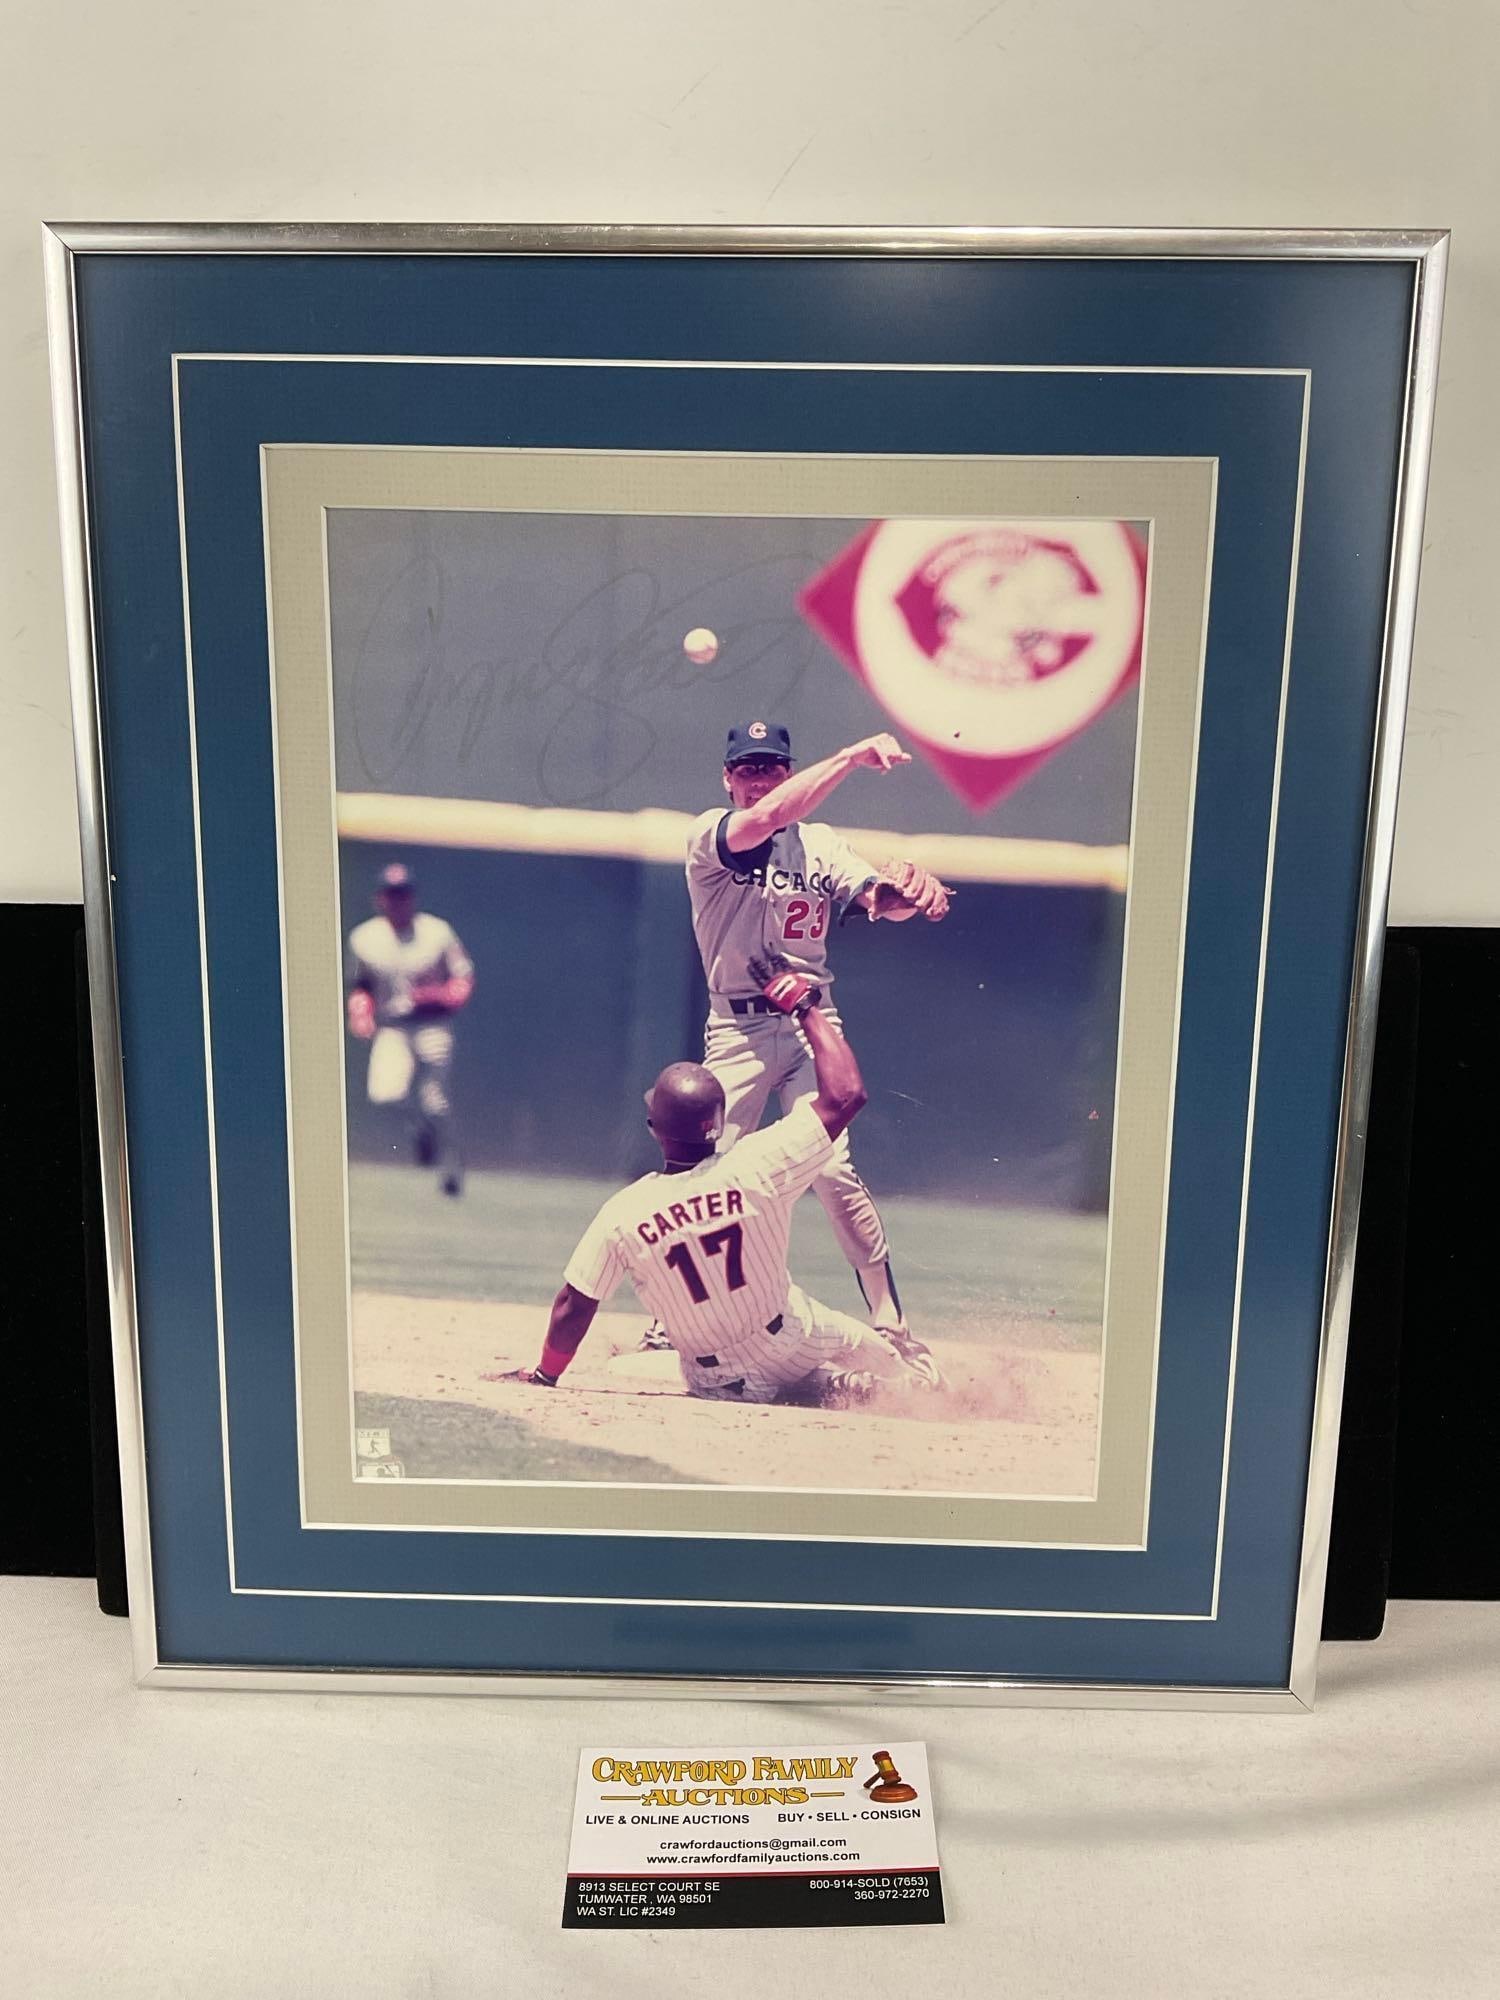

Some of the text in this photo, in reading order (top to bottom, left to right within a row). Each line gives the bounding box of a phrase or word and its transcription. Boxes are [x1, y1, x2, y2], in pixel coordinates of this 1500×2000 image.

[783, 899, 825, 939] 23
[637, 1189, 744, 1244] CARTER
[664, 1222, 747, 1304] 17
[592, 1756, 858, 1786] CRAWFORD FAMILY
[641, 1787, 809, 1806] AUCTIONS
[586, 1814, 750, 1825] LIVE & ONLINE AUCTIONS
[777, 1808, 921, 1823] BUY SELL CONSIGN
[659, 1837, 847, 1851] crawfordauctions@gmail.com
[646, 1851, 860, 1865] www.crawfordfamilyauctions.com
[578, 1881, 720, 1892] 8913 SELECT COURT SE
[809, 1876, 929, 1890] 800-914-SOLD (7653)
[656, 1894, 676, 1904] WA
[679, 1894, 712, 1904] 98501
[854, 1888, 930, 1900] 360-972-2270
[576, 1907, 597, 1917] WA
[619, 1906, 639, 1916] LIC
[641, 1906, 676, 1917] #2349
